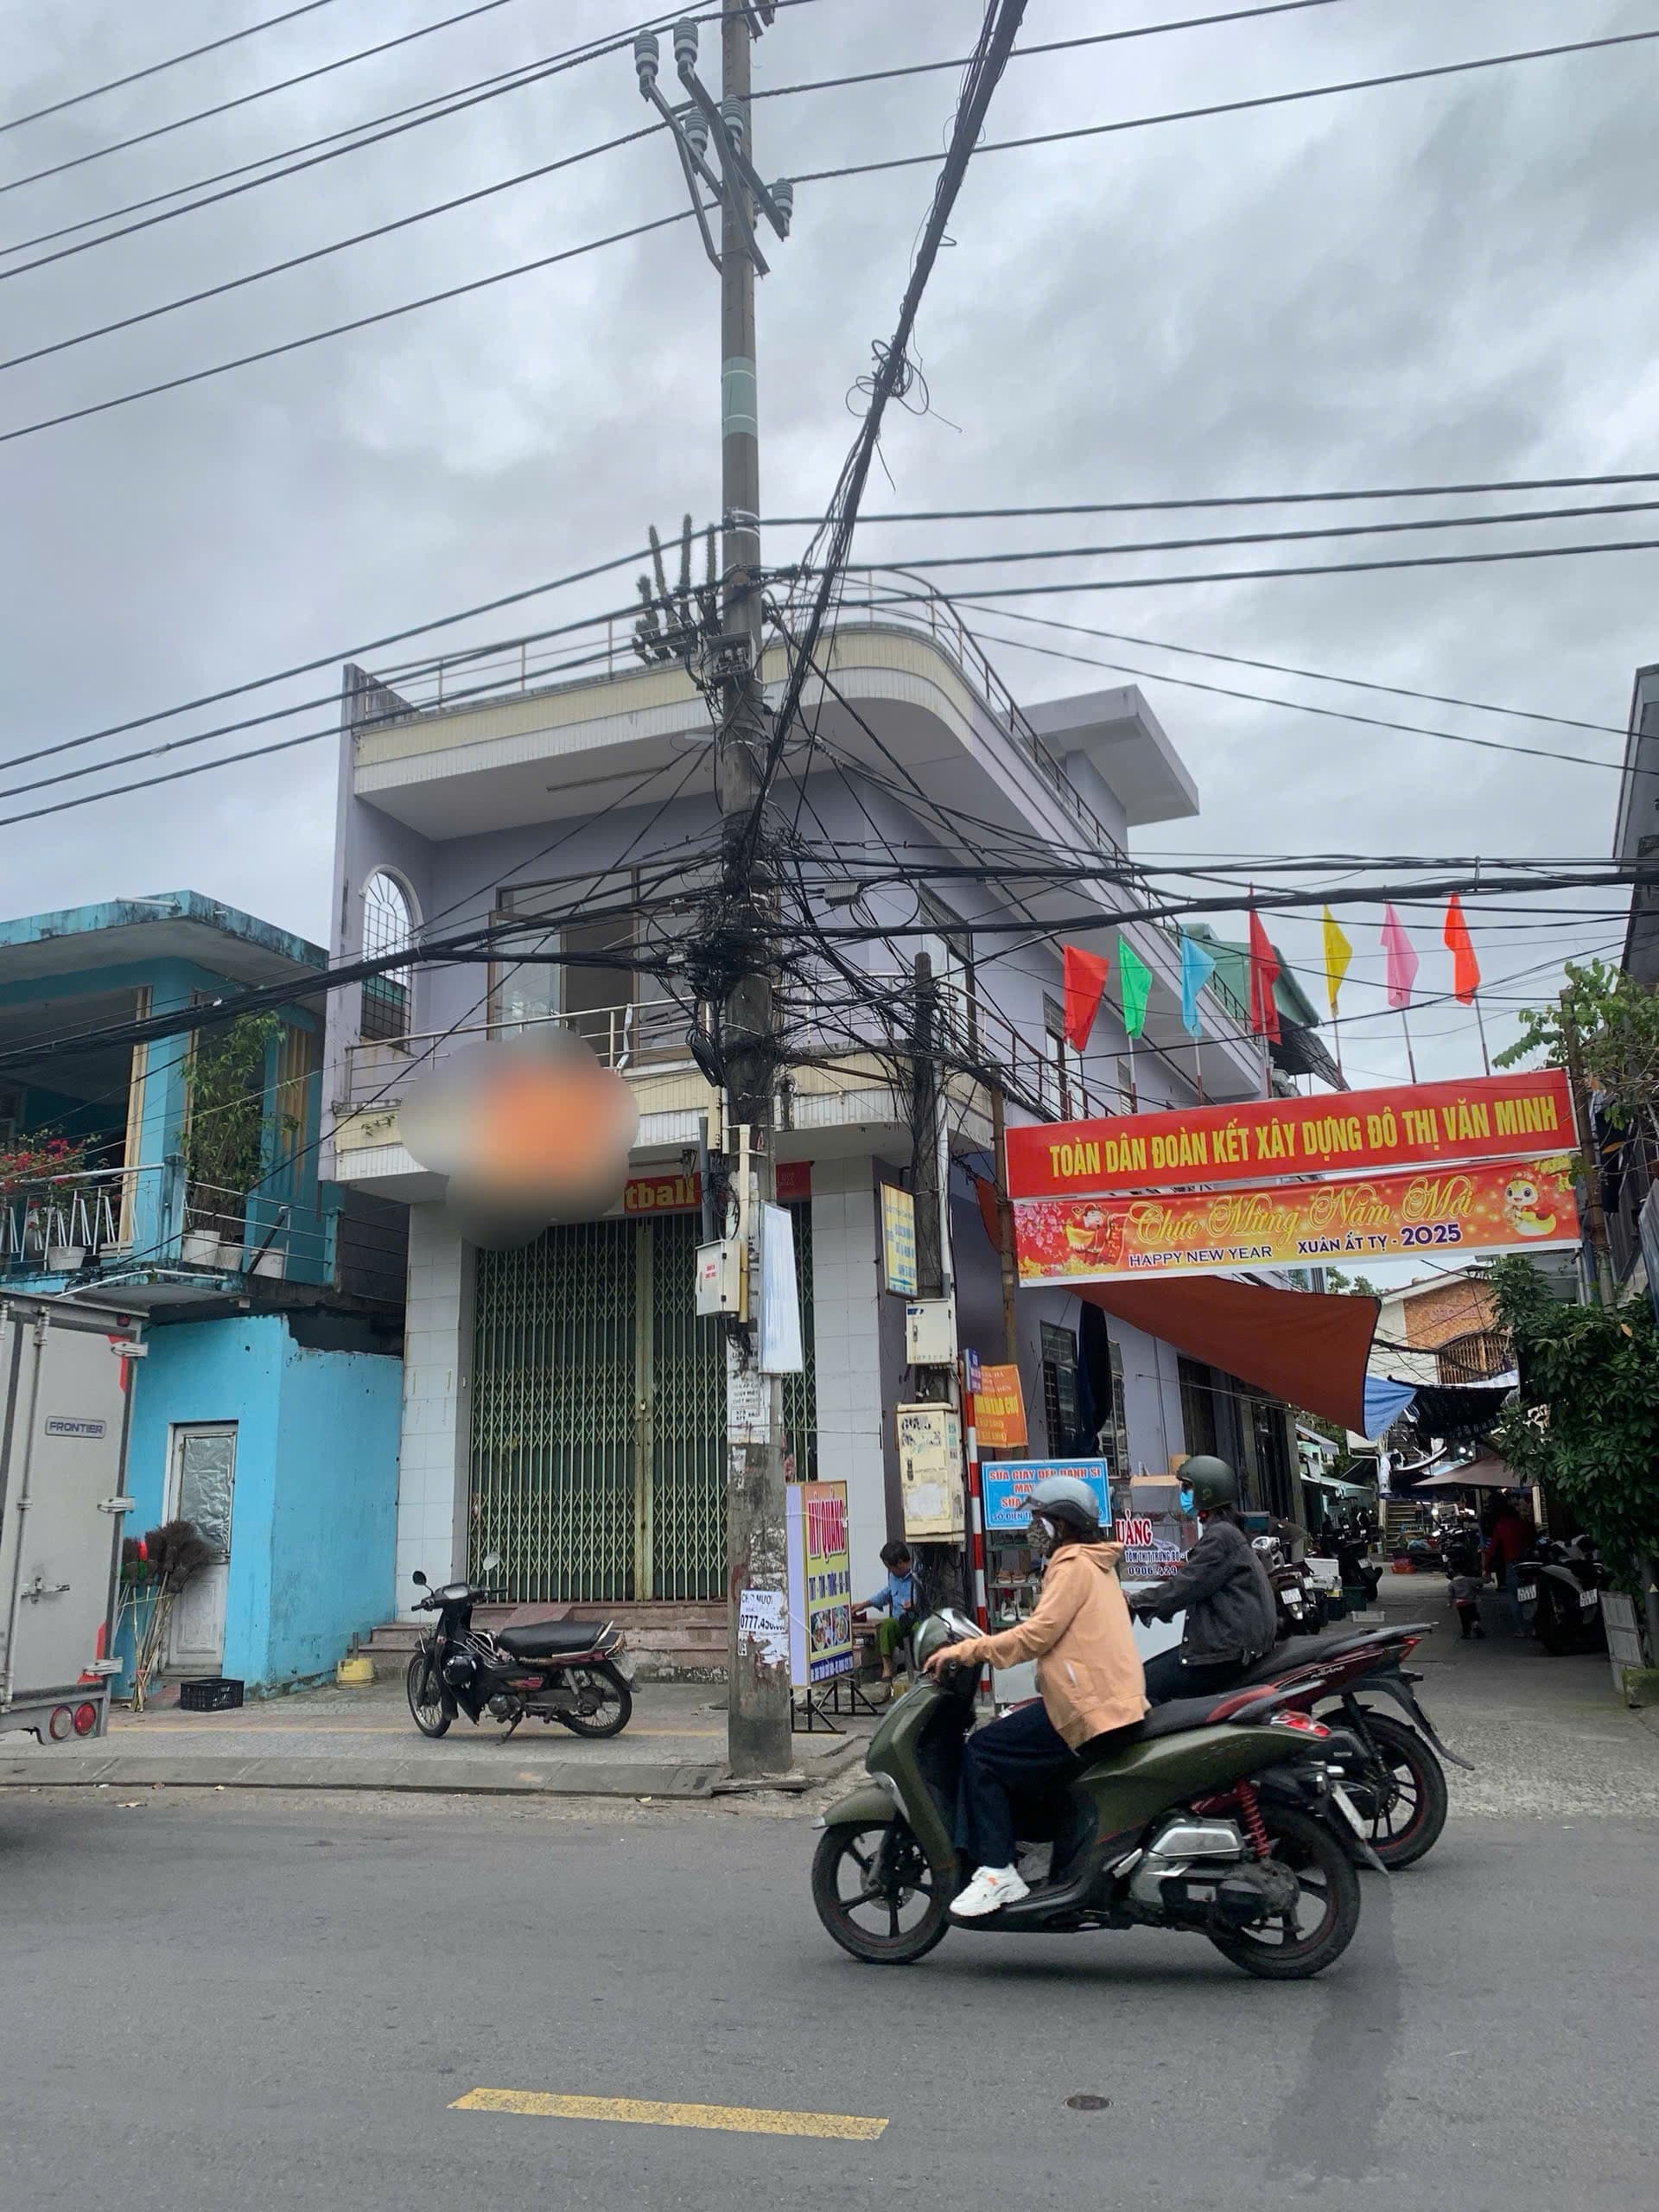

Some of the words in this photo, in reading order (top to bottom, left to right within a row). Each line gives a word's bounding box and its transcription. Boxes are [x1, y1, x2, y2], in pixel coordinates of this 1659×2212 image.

[1050, 1136, 1101, 1178] TOÀN
[1105, 1132, 1147, 1173] DÂN
[1152, 1127, 1208, 1169] ĐOÀN
[1212, 1118, 1249, 1164] KẾT
[1255, 1118, 1296, 1160] XÂY
[1301, 1116, 1363, 1161] DỰNG
[1367, 1106, 1398, 1149] ĐÔ
[1402, 1109, 1440, 1151] THỊ
[1441, 1097, 1491, 1141] VĂN
[1494, 1096, 1559, 1136] MINH
[1128, 1201, 1202, 1245] Chúc
[1209, 1193, 1300, 1250] Mừng
[1309, 1184, 1395, 1230] Năm
[1401, 1175, 1475, 1223] Mới
[1129, 1253, 1181, 1267] HAPPY
[1187, 1249, 1228, 1262] NEW
[1229, 1246, 1273, 1260] YEAR
[1298, 1237, 1340, 1255] XUÂN
[1345, 1231, 1363, 1251] ẤT
[1401, 1224, 1462, 1246] 2025
[49, 1421, 104, 1434] FRONTIER
[1115, 1509, 1153, 1547] UẢNG
